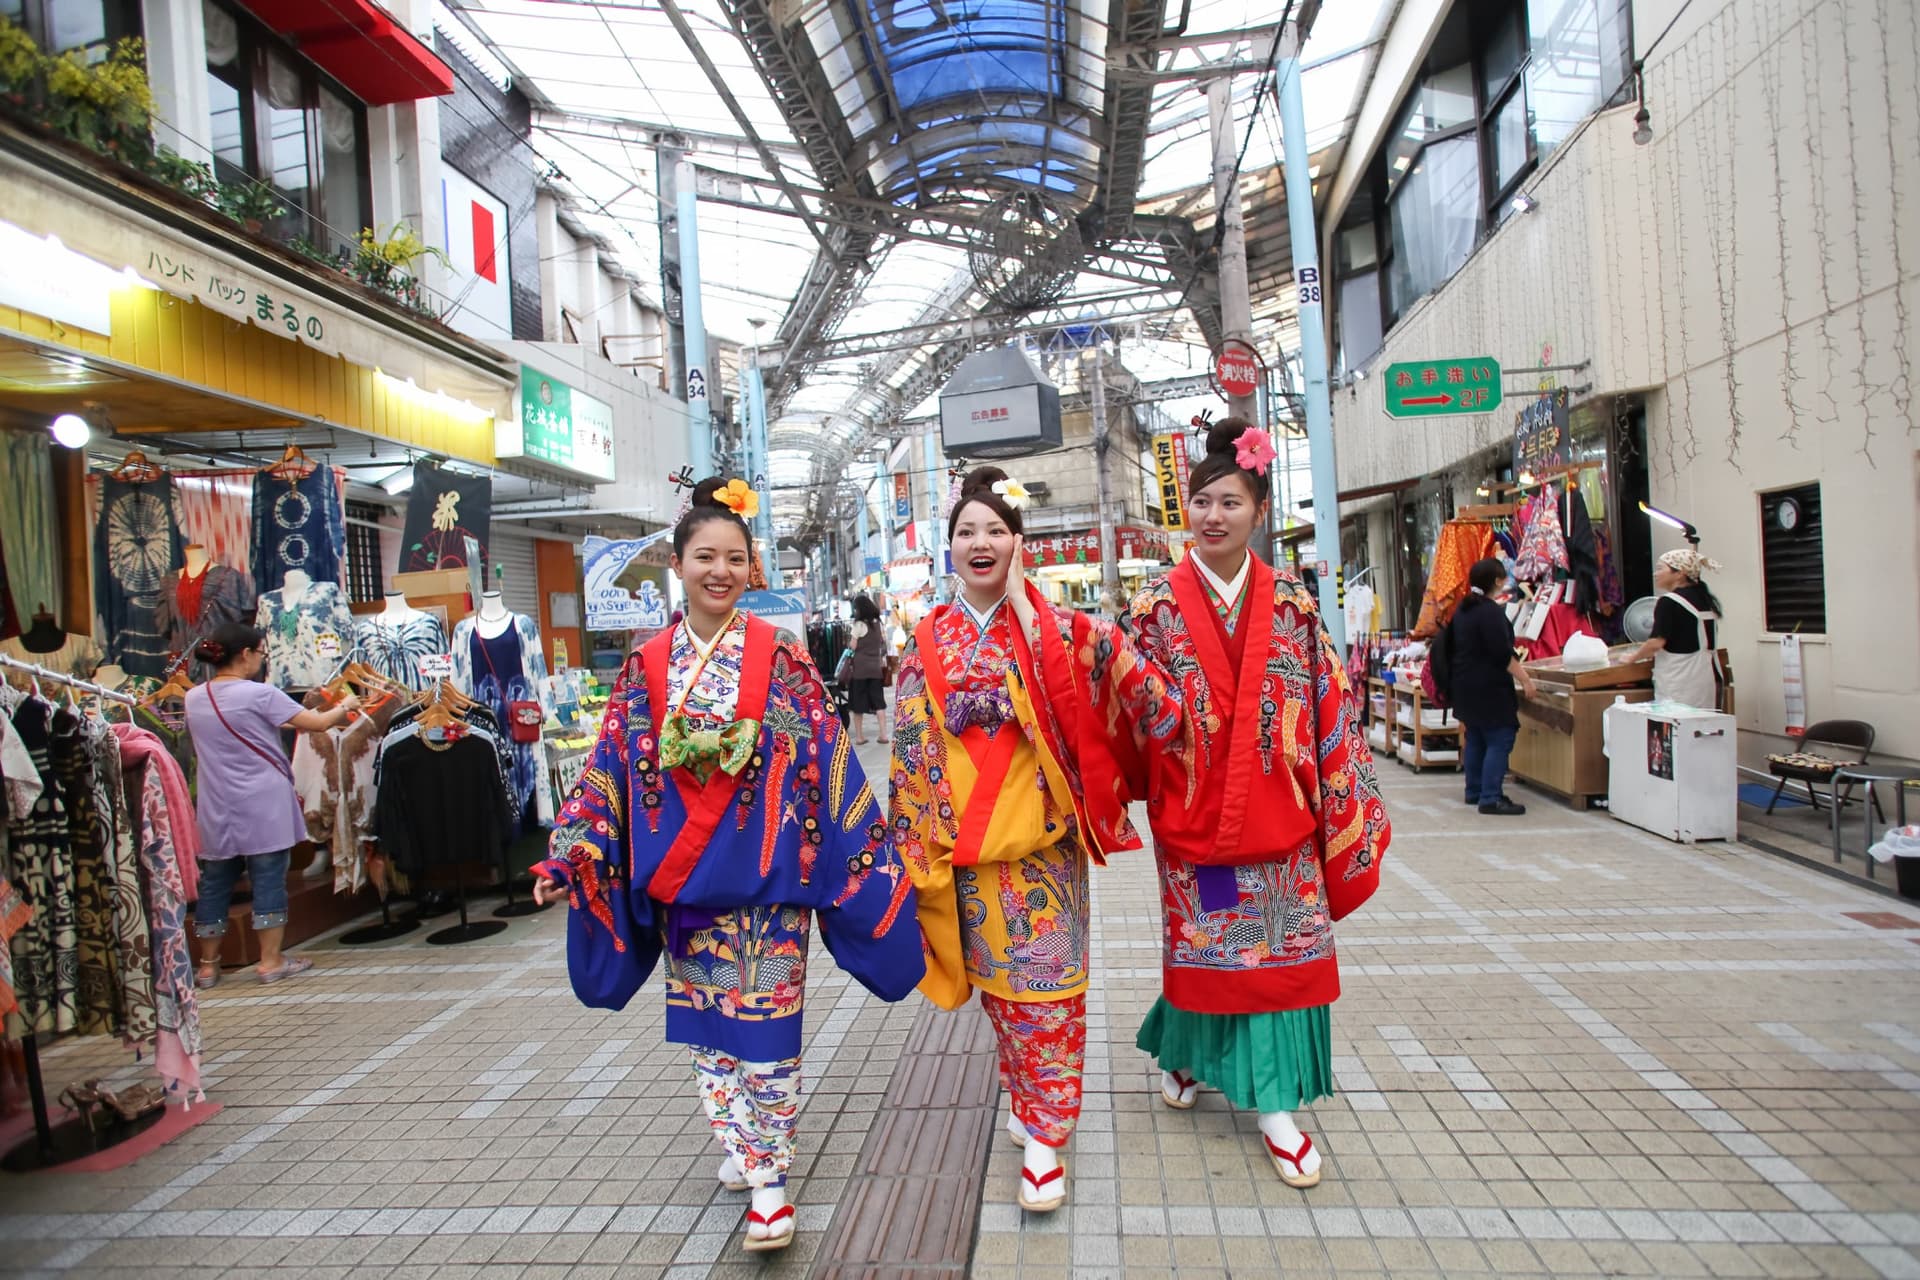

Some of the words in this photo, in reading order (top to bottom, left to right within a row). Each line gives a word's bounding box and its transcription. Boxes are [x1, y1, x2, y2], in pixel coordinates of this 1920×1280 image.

[1299, 267, 1318, 284] B
[148, 251, 195, 284] ハンド
[255, 293, 324, 341] まるの
[1300, 286, 1320, 304] 38
[688, 368, 705, 382] A
[1219, 362, 1256, 384] 消火栓
[1396, 367, 1491, 387] お手洗い
[688, 385, 706, 399] 34
[1460, 387, 1489, 407] 2F
[971, 407, 1009, 421] 広告募集
